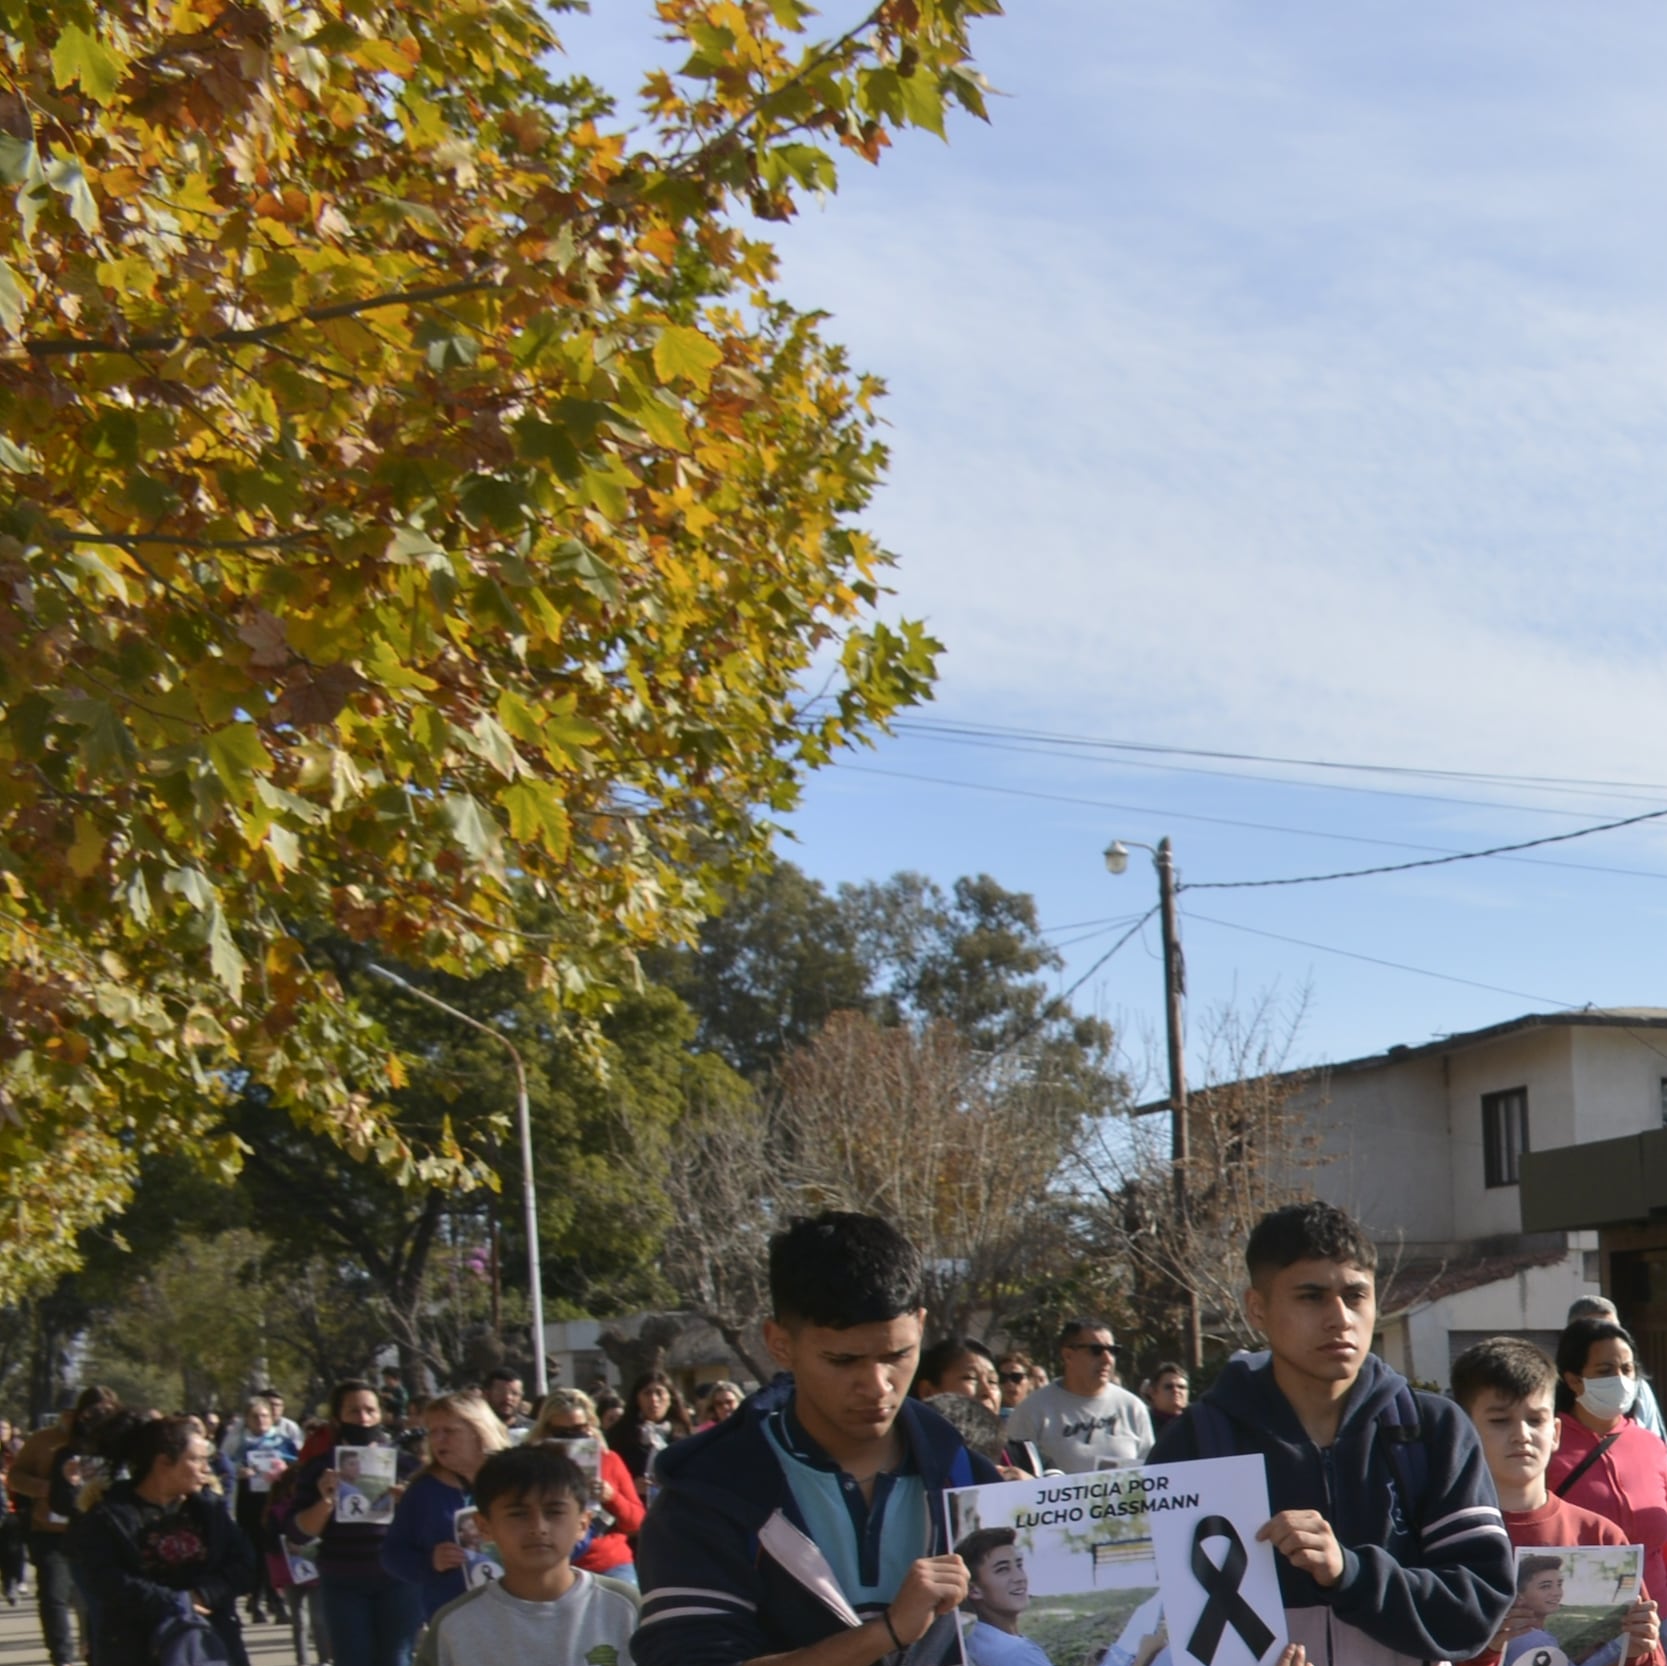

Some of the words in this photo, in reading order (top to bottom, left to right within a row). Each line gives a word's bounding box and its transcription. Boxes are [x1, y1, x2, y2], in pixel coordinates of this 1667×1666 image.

[1062, 1415, 1117, 1445] enjoy
[1036, 1482, 1121, 1505] JUSTICIA
[1128, 1475, 1169, 1494] POR
[1015, 1507, 1084, 1529] LUCHO
[1089, 1493, 1200, 1520] GASSMANN
